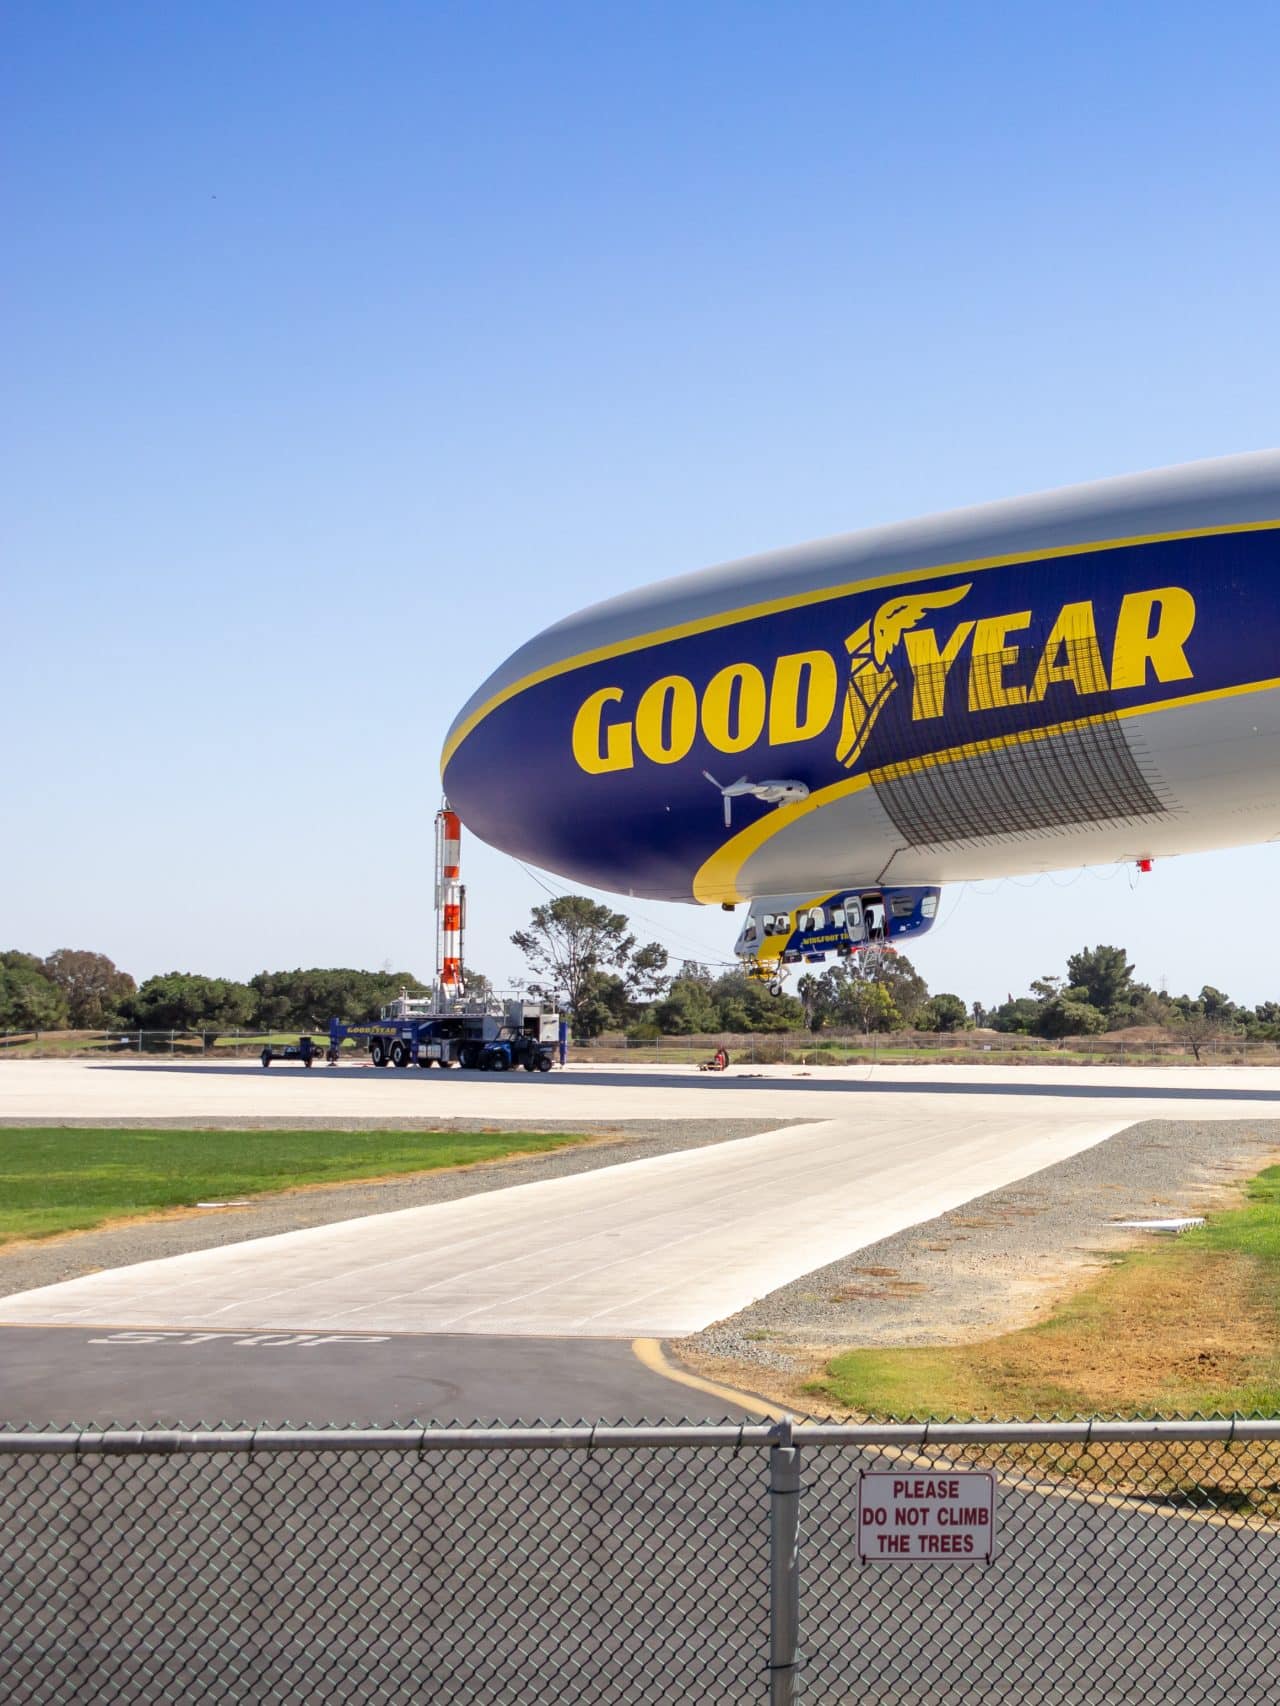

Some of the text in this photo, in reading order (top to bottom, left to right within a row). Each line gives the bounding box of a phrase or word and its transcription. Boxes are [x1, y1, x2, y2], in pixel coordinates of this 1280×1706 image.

[87, 1331, 393, 1347] STOP
[893, 1480, 959, 1499] PLEASE
[862, 1507, 989, 1526] DO NOT CLIMB
[877, 1535, 974, 1553] THE TREES
